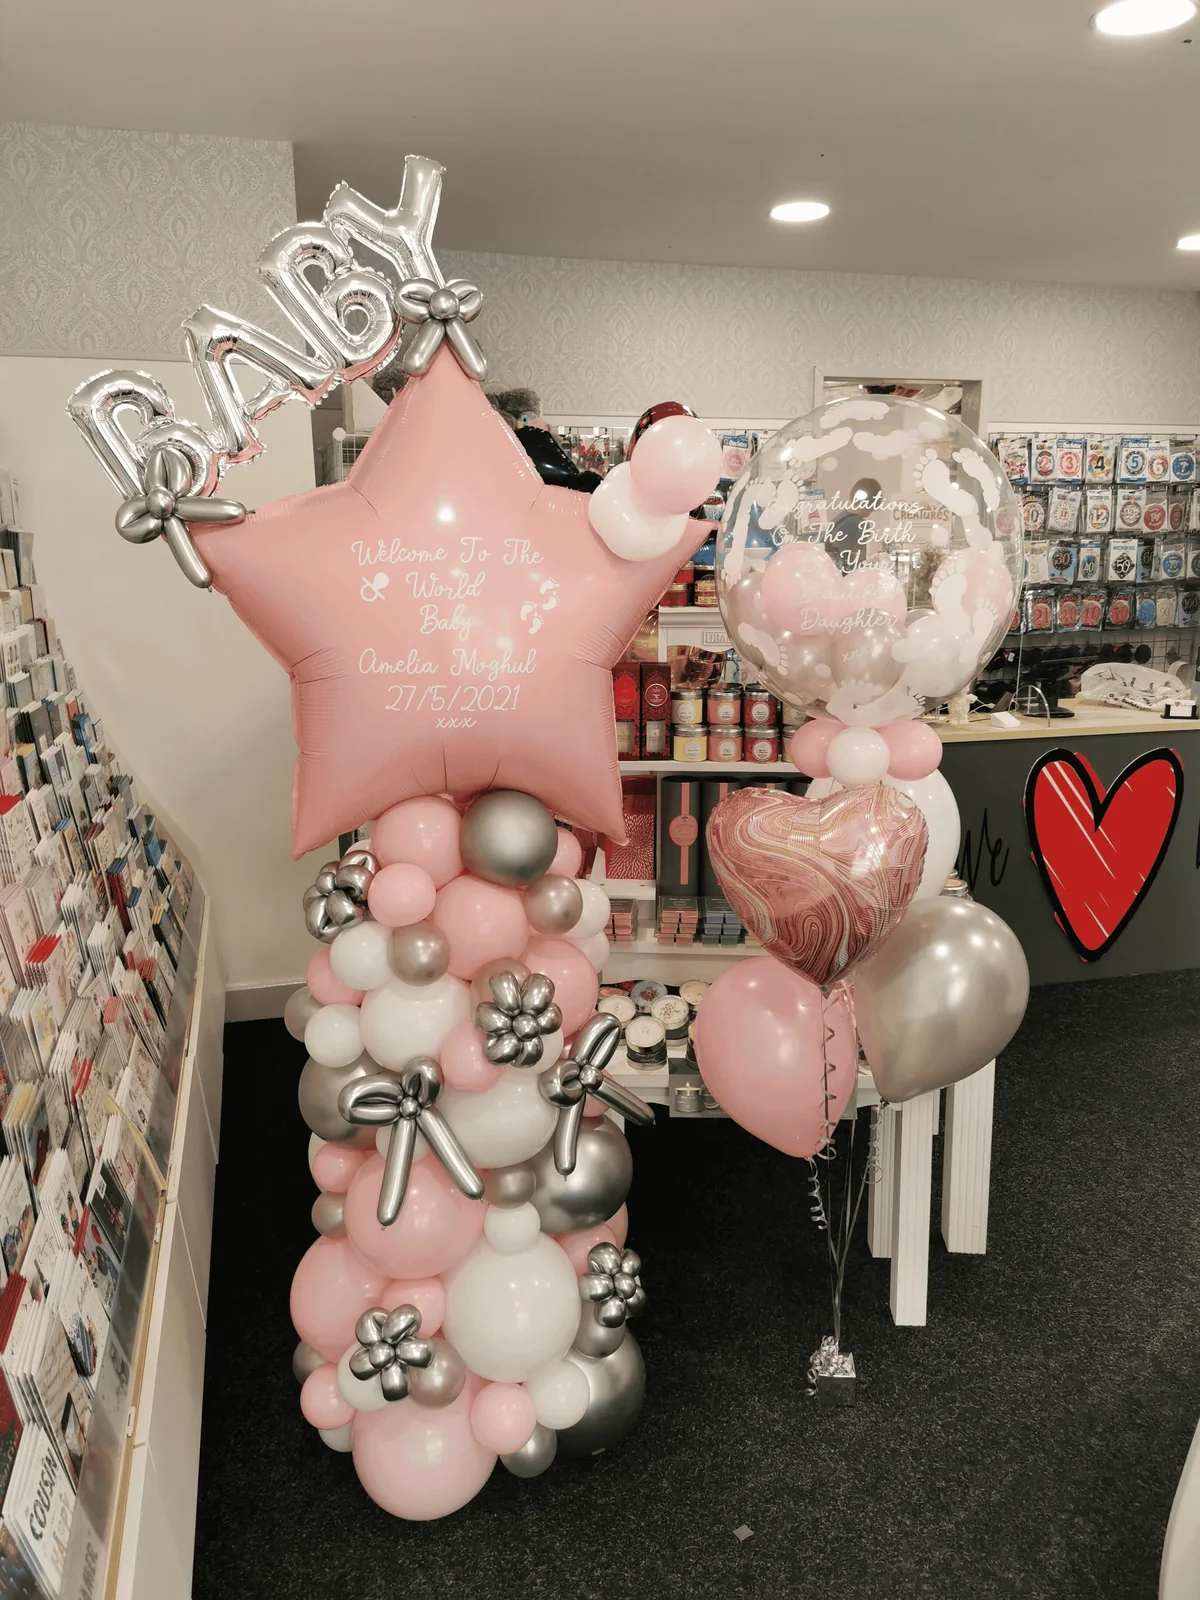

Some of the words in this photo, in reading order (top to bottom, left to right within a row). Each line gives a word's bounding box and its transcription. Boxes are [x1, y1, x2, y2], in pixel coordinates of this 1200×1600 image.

[64, 154, 448, 500] BABY
[1065, 456, 1074, 470] 3
[1094, 456, 1106, 471] 4
[1131, 455, 1140, 469] 5
[1153, 458, 1164, 474] 6
[1091, 509, 1107, 524] 12
[772, 524, 799, 547] On
[808, 522, 848, 544] The
[858, 520, 917, 545] Birth
[351, 538, 448, 566] Welcome
[460, 536, 492, 564] To
[502, 538, 544, 565] The
[1055, 552, 1071, 565] 30
[1084, 561, 1095, 572] 40
[1116, 559, 1131, 574] 50
[406, 571, 486, 601] World
[800, 608, 898, 634] Daughter
[1034, 607, 1049, 625] 21
[1060, 609, 1077, 624] 30
[1081, 606, 1101, 624] 40
[1112, 606, 1129, 621] 50
[419, 604, 474, 641] Baby
[358, 648, 439, 675] Amelia
[450, 647, 537, 682] Moghul
[385, 684, 521, 712] 27/5/2021
[436, 716, 477, 729] xxx
[29, 1447, 58, 1542] COUSIN
